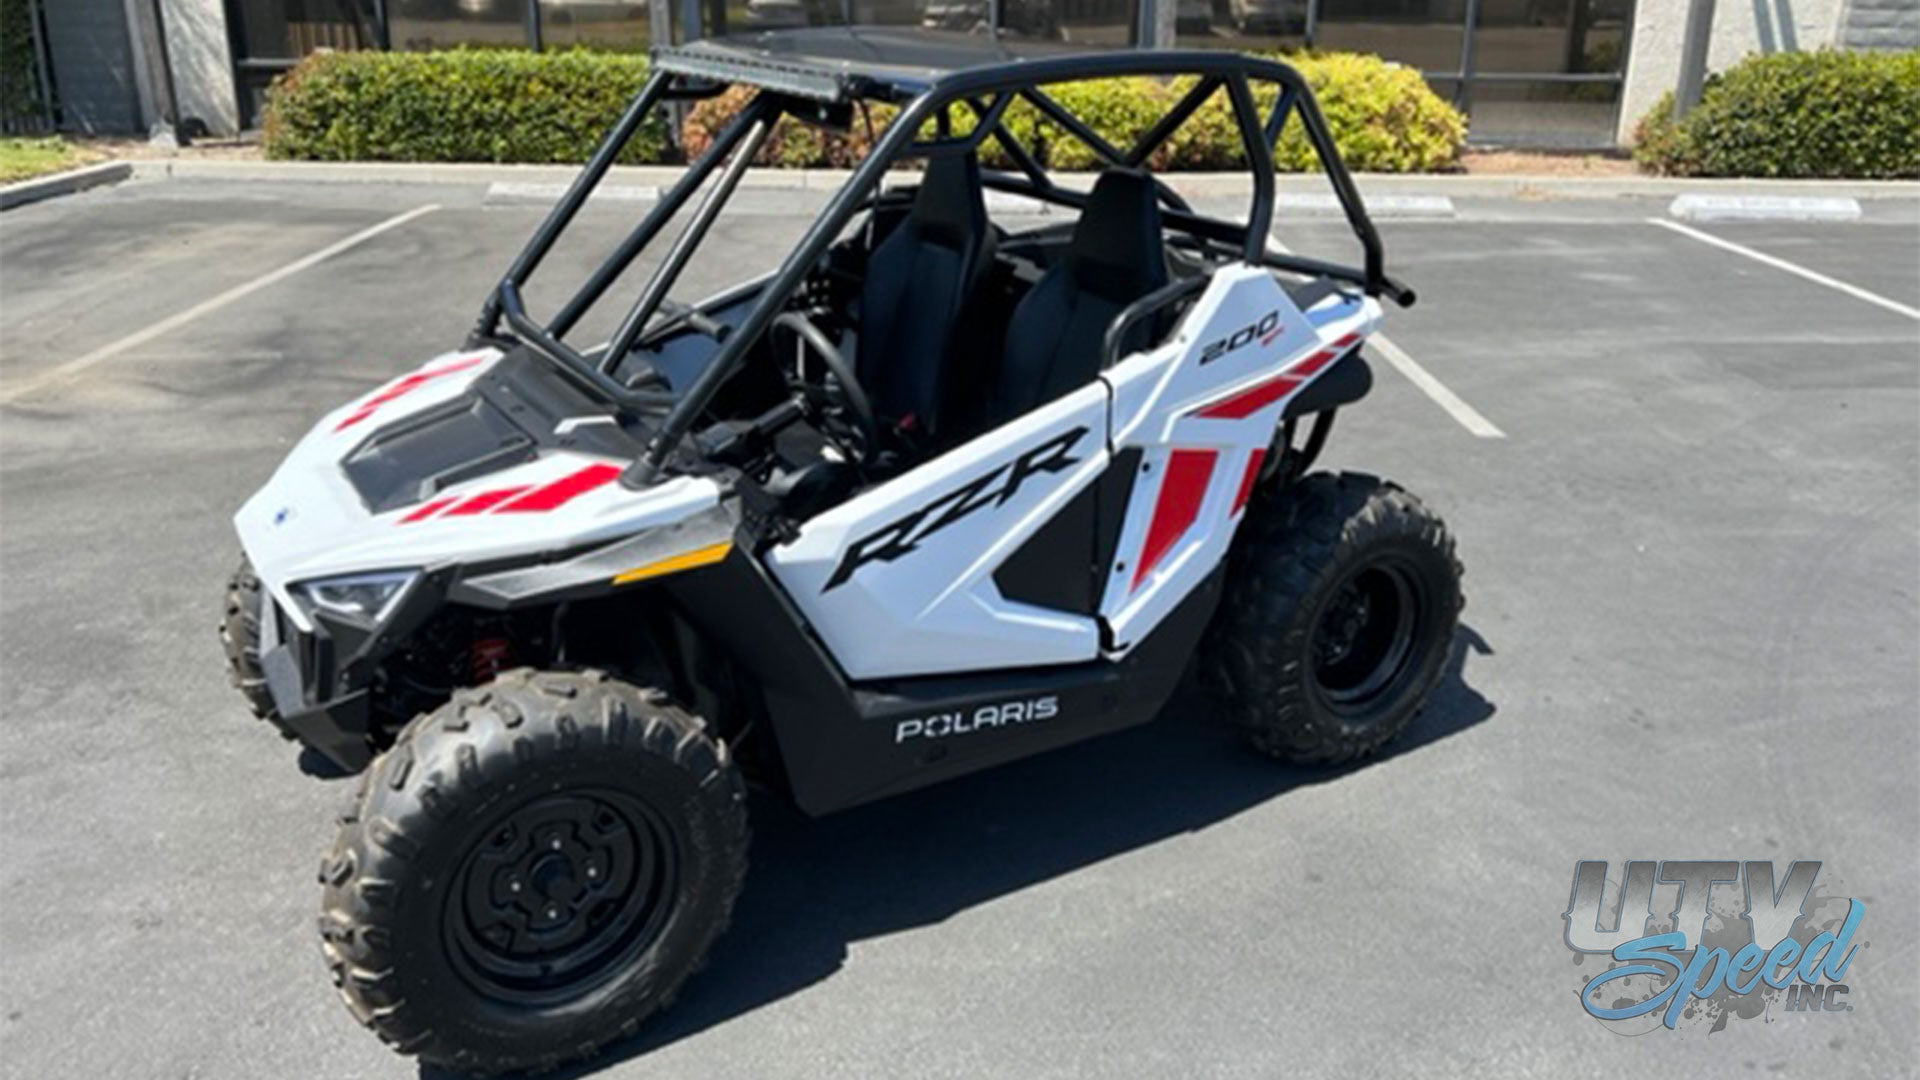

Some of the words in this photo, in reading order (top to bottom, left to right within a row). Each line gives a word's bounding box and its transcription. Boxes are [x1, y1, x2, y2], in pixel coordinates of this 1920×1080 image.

[1199, 310, 1279, 366] 200
[820, 425, 1090, 595] RZR
[895, 696, 1058, 744] POLARIS
